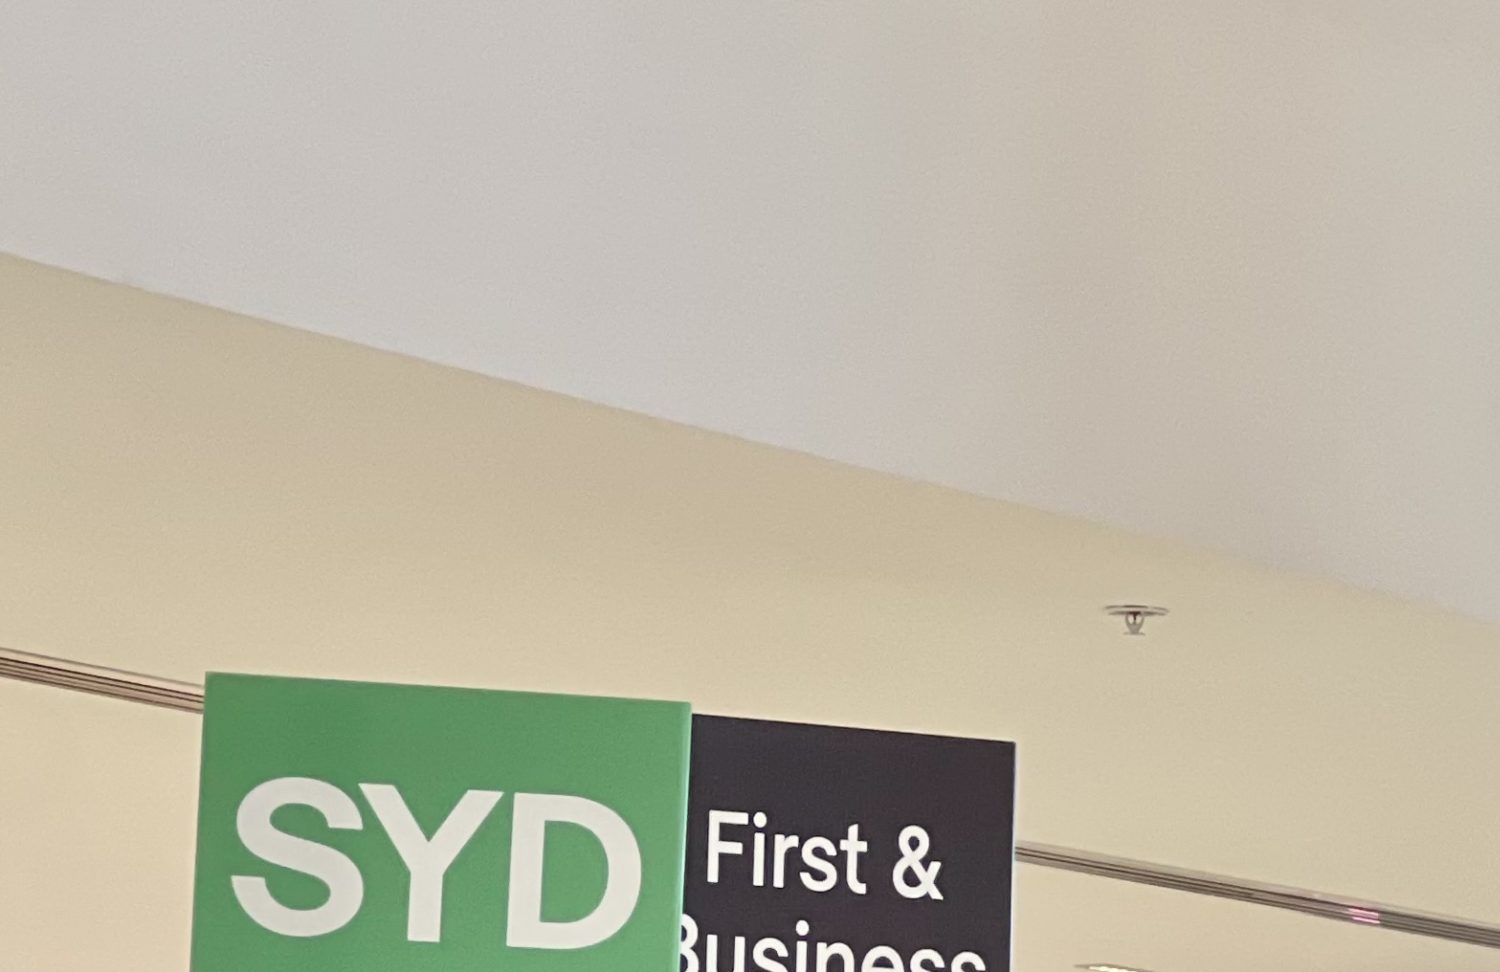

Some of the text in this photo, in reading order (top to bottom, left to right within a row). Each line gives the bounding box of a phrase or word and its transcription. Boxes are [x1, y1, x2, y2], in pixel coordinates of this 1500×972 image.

[232, 778, 641, 950] SYD
[707, 809, 944, 901] First &
